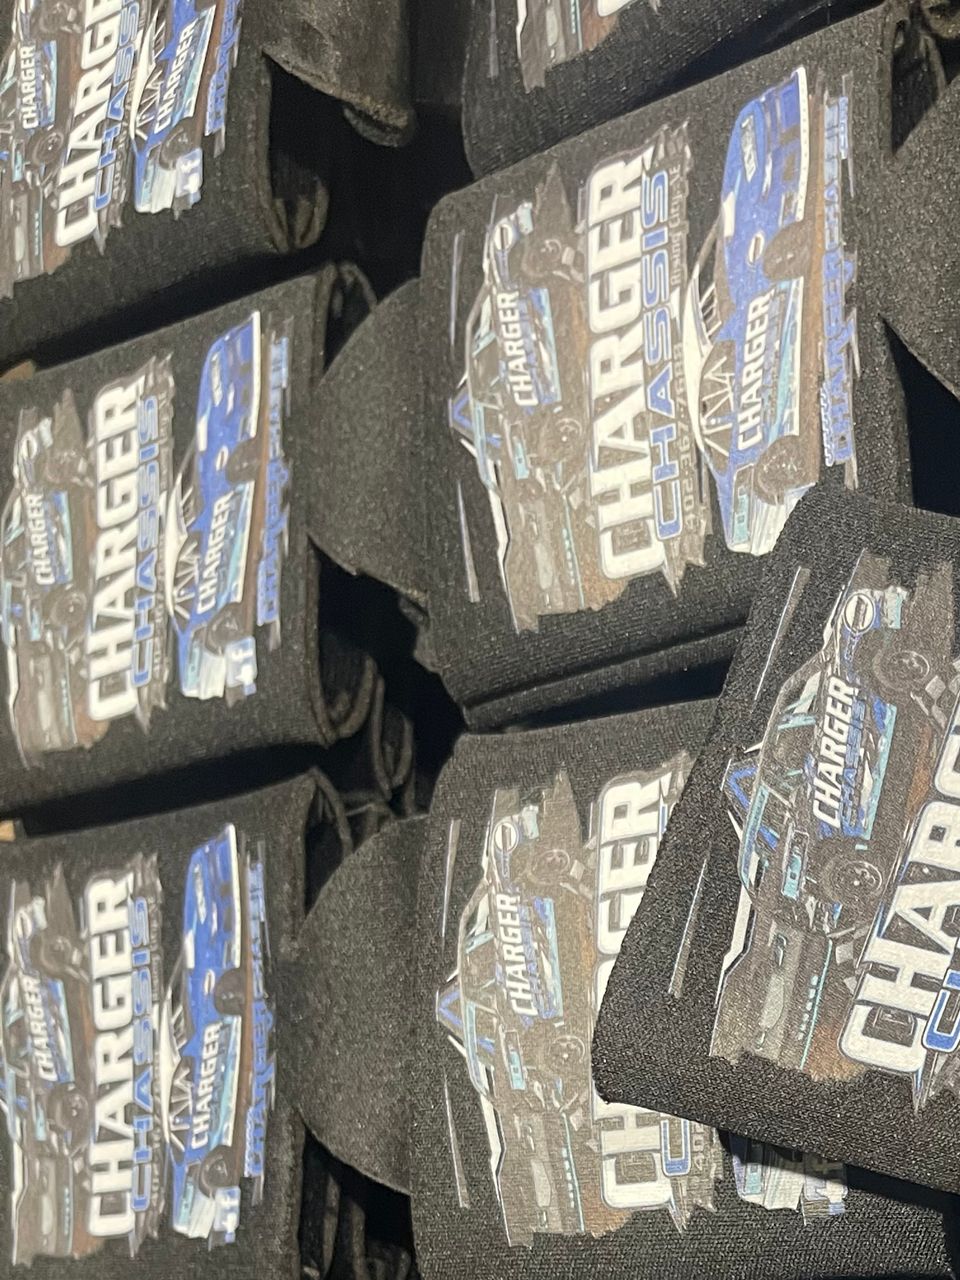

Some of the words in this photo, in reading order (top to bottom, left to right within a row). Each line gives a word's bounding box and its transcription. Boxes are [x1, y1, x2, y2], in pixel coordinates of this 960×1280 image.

[55, 0, 139, 243] CHARGE
[92, 0, 146, 207] CHASS
[494, 288, 540, 410] CHARGER
[581, 142, 666, 577] CHARGER
[642, 170, 687, 537] CHASSIS
[736, 286, 773, 449] CHARGER
[23, 491, 55, 587] CHARGER
[90, 373, 144, 717] CHARGER
[130, 396, 157, 684] CHASSIS
[195, 488, 232, 613] CHARGER
[812, 675, 860, 830] CHARGER
[20, 975, 57, 1081] CHARGER
[82, 869, 138, 1233] CHARGER
[127, 898, 153, 1208] CHASSIS
[493, 892, 540, 1018] CHARGER
[593, 769, 673, 1205] CHGER
[190, 1018, 221, 1147] CHARGER
